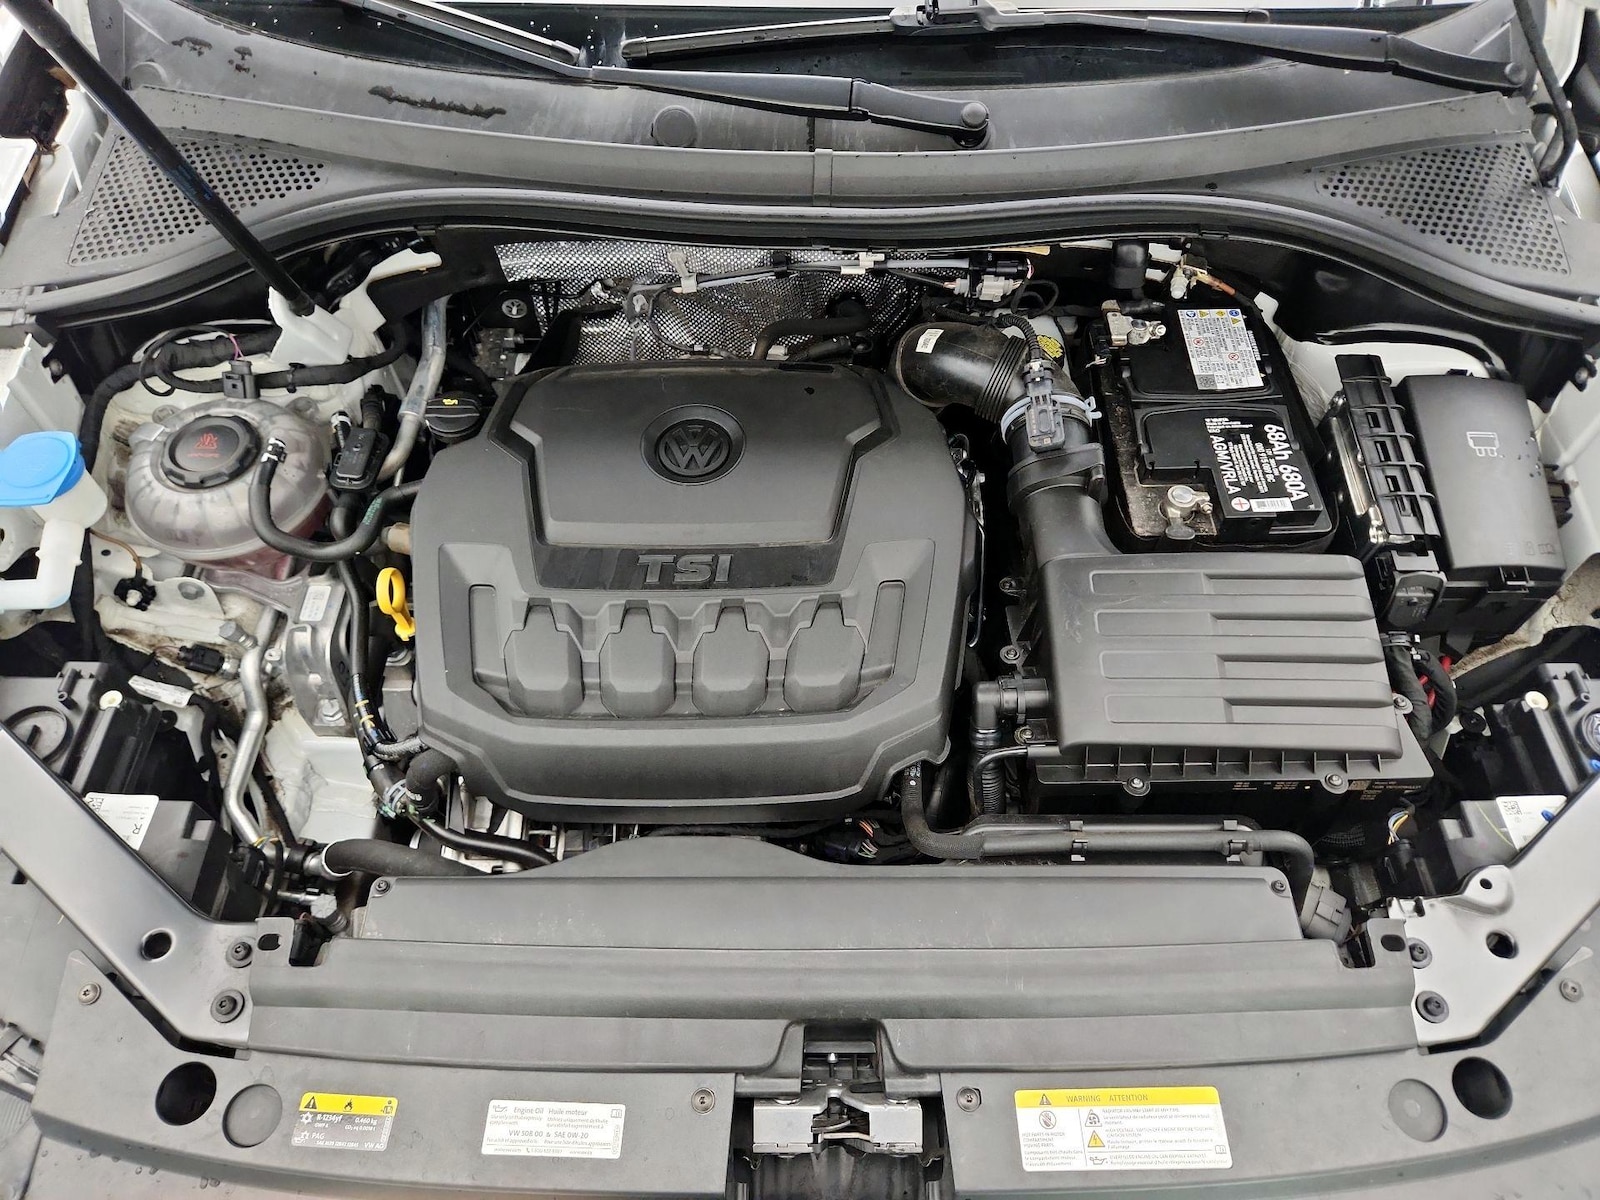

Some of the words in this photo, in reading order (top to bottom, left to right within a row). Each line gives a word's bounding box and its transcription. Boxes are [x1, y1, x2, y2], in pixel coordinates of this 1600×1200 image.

[1264, 424, 1293, 460] 68Ah
[1279, 464, 1309, 502] 680A
[637, 554, 733, 585] TSI
[316, 1114, 343, 1123] R-1234yf
